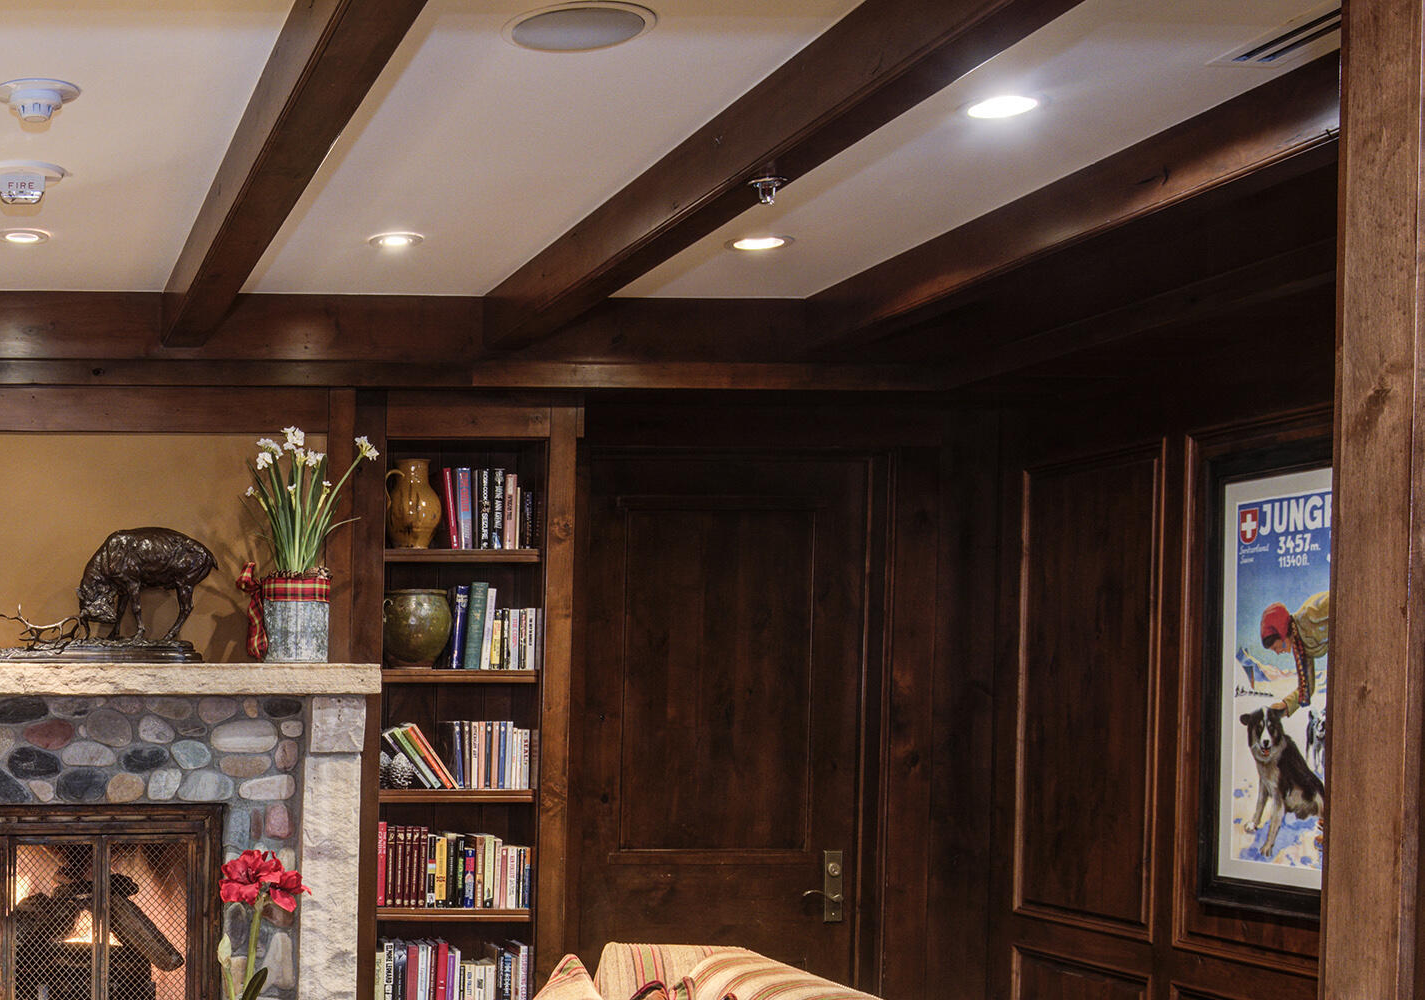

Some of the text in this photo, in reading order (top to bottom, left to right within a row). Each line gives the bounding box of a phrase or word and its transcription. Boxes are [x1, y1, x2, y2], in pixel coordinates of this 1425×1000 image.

[8, 181, 35, 190] FIRE
[481, 512, 489, 540] SEIZURE
[385, 944, 393, 984] ELMORE LEONARD
